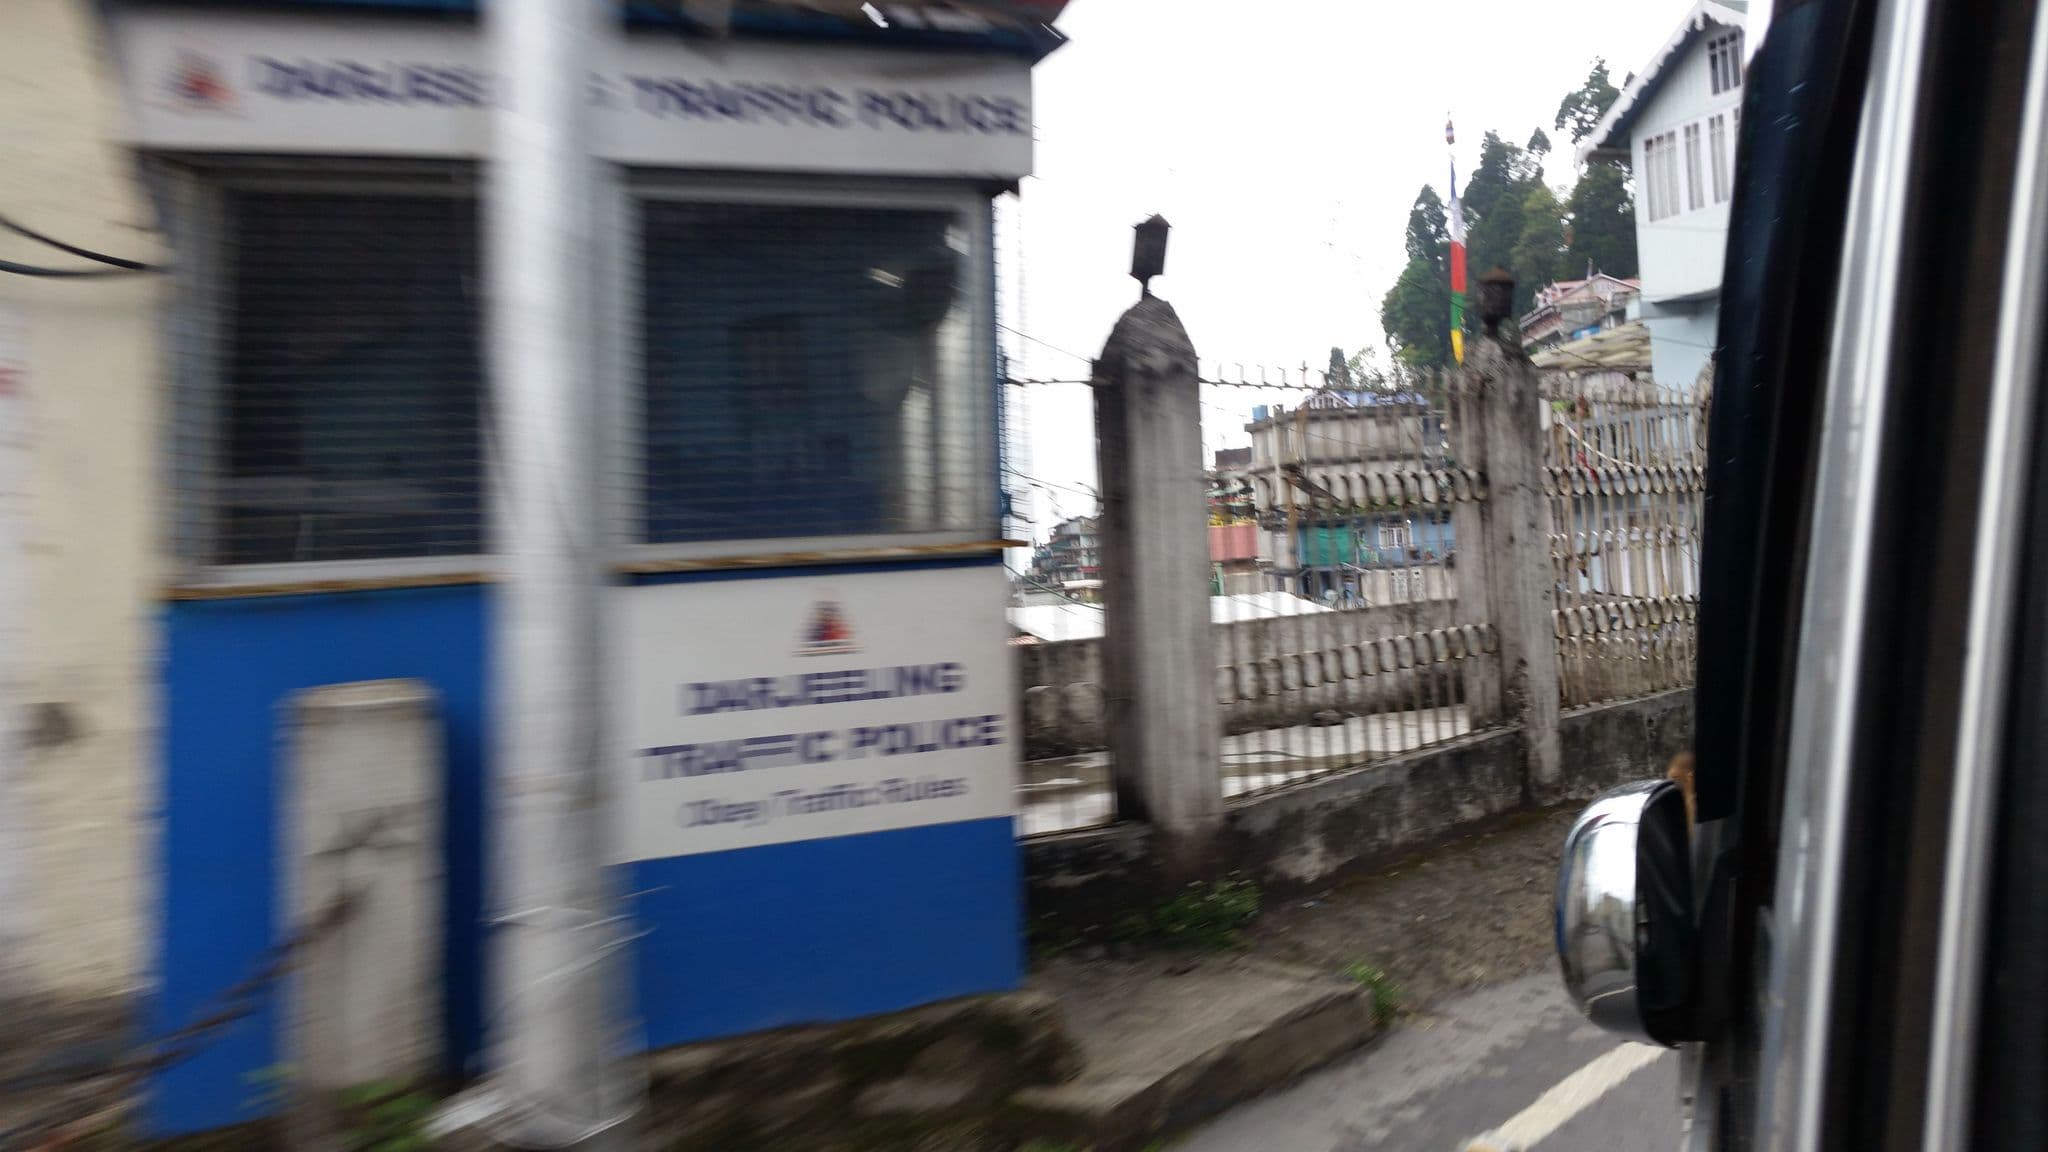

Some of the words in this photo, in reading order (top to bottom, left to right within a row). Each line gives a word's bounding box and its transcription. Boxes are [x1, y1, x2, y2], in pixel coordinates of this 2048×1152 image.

[624, 74, 850, 128] TRAFFIC
[853, 88, 1029, 133] POLICE
[682, 663, 965, 715] DARJEELING
[637, 731, 836, 781] TRAFFIC
[844, 714, 1004, 759] POLICE
[876, 777, 968, 802] Rules
